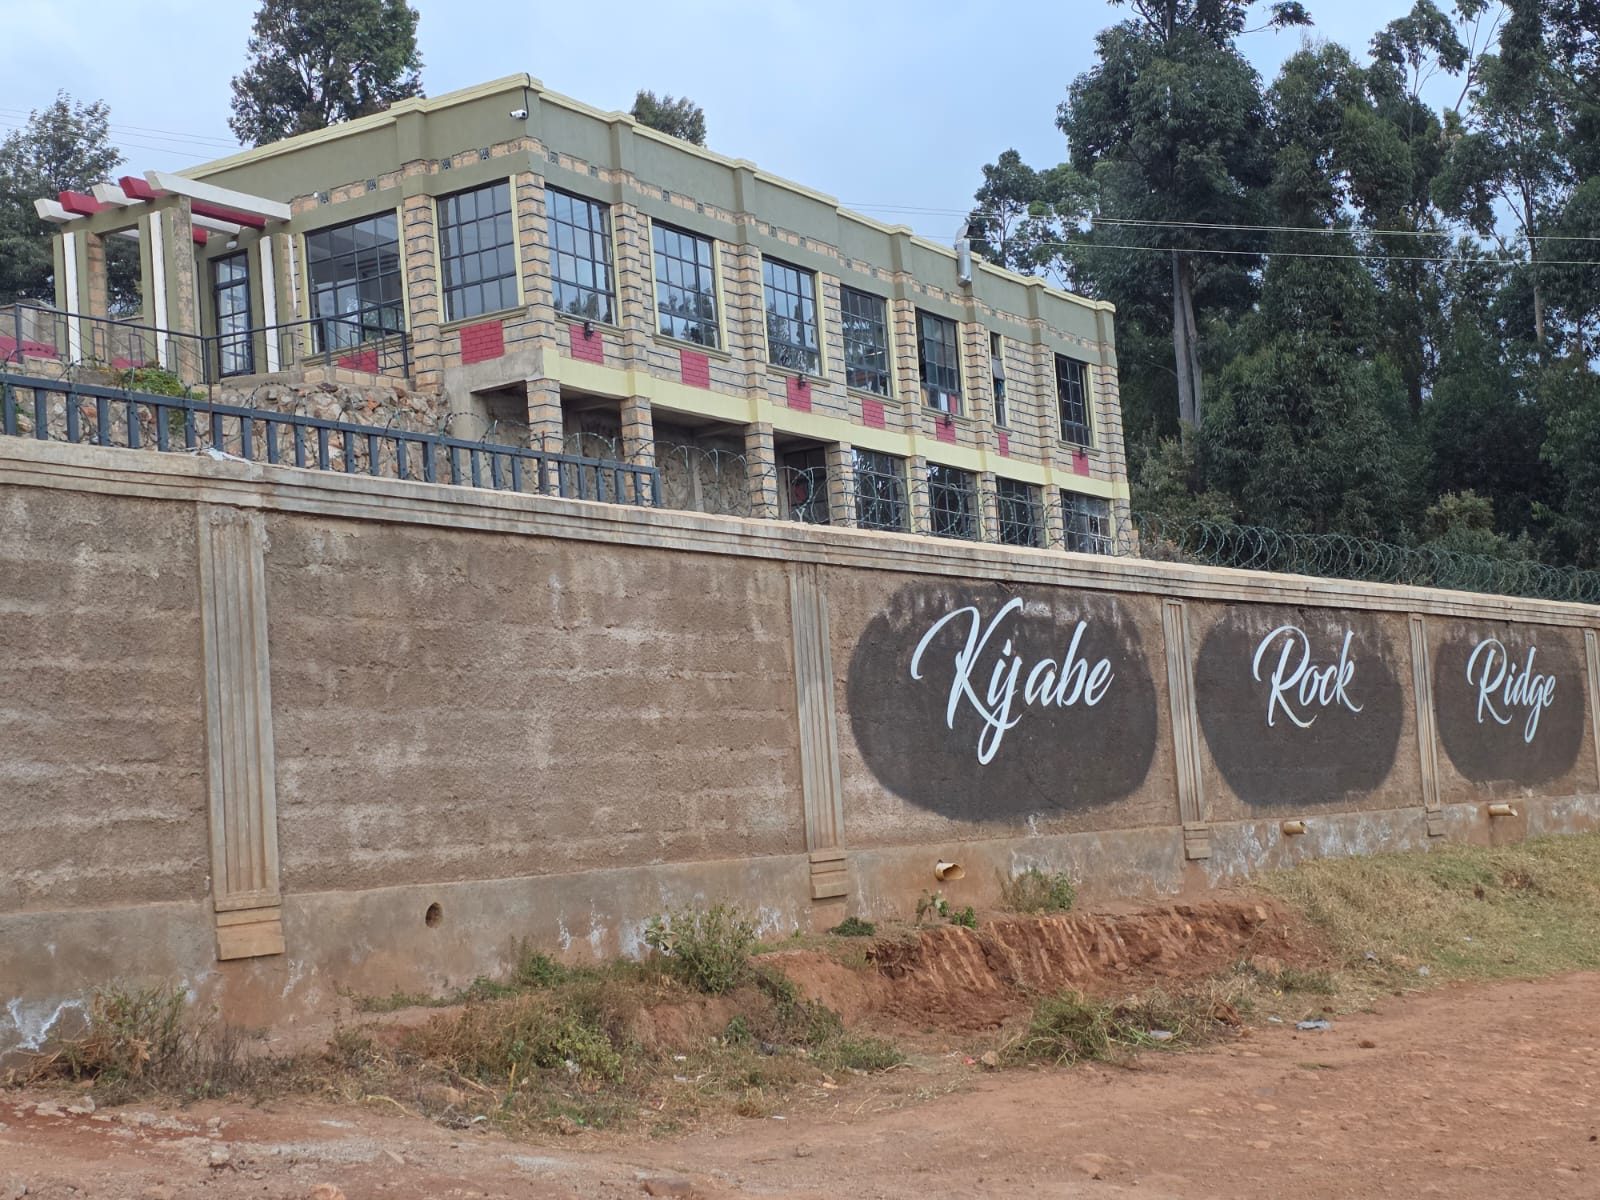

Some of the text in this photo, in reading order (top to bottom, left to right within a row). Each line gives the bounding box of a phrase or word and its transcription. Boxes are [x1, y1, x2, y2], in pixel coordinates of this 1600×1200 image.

[910, 596, 1556, 765] Kijabe Rock Ridge
